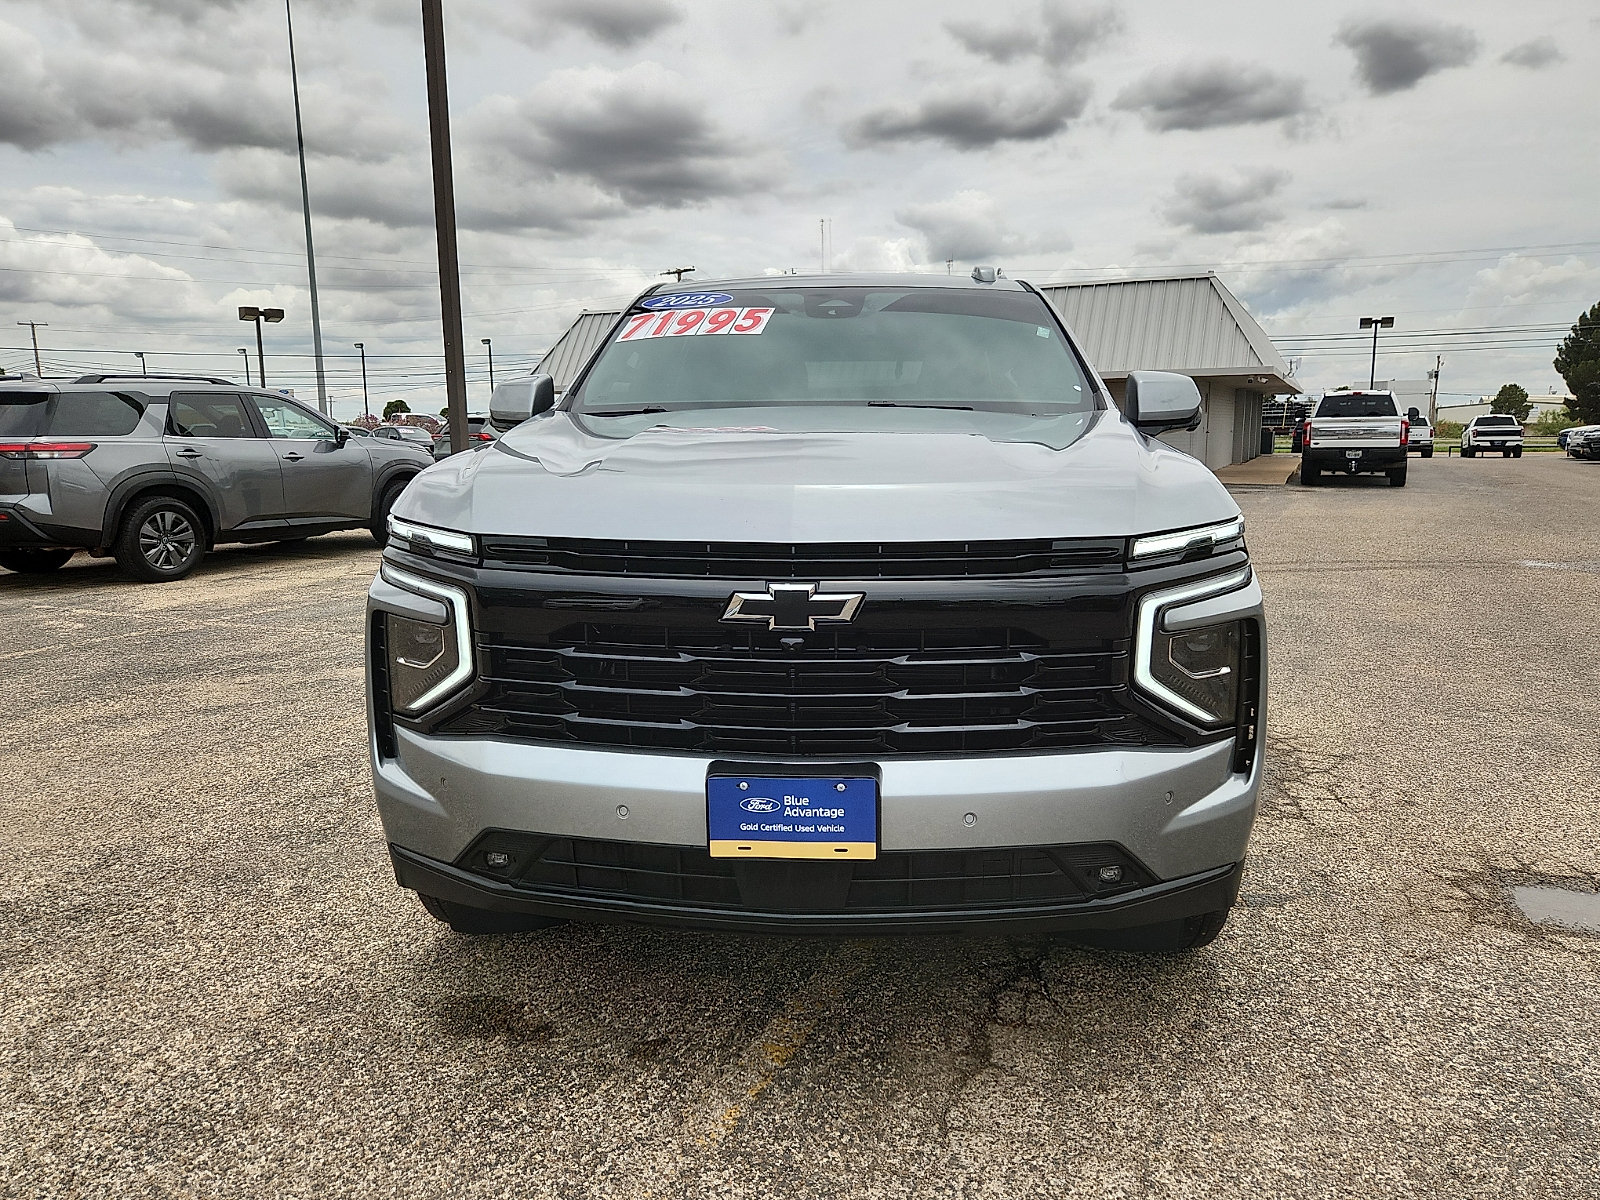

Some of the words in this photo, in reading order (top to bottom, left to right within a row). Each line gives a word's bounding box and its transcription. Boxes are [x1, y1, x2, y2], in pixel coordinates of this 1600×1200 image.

[652, 294, 718, 307] 2025
[621, 308, 771, 340] 71995
[748, 800, 773, 811] Ford
[784, 795, 809, 806] Blue
[784, 807, 845, 818] Advantage
[740, 823, 758, 831] Gold
[760, 823, 793, 832] Certified
[795, 824, 815, 832] Used
[817, 824, 845, 832] Vehicle
